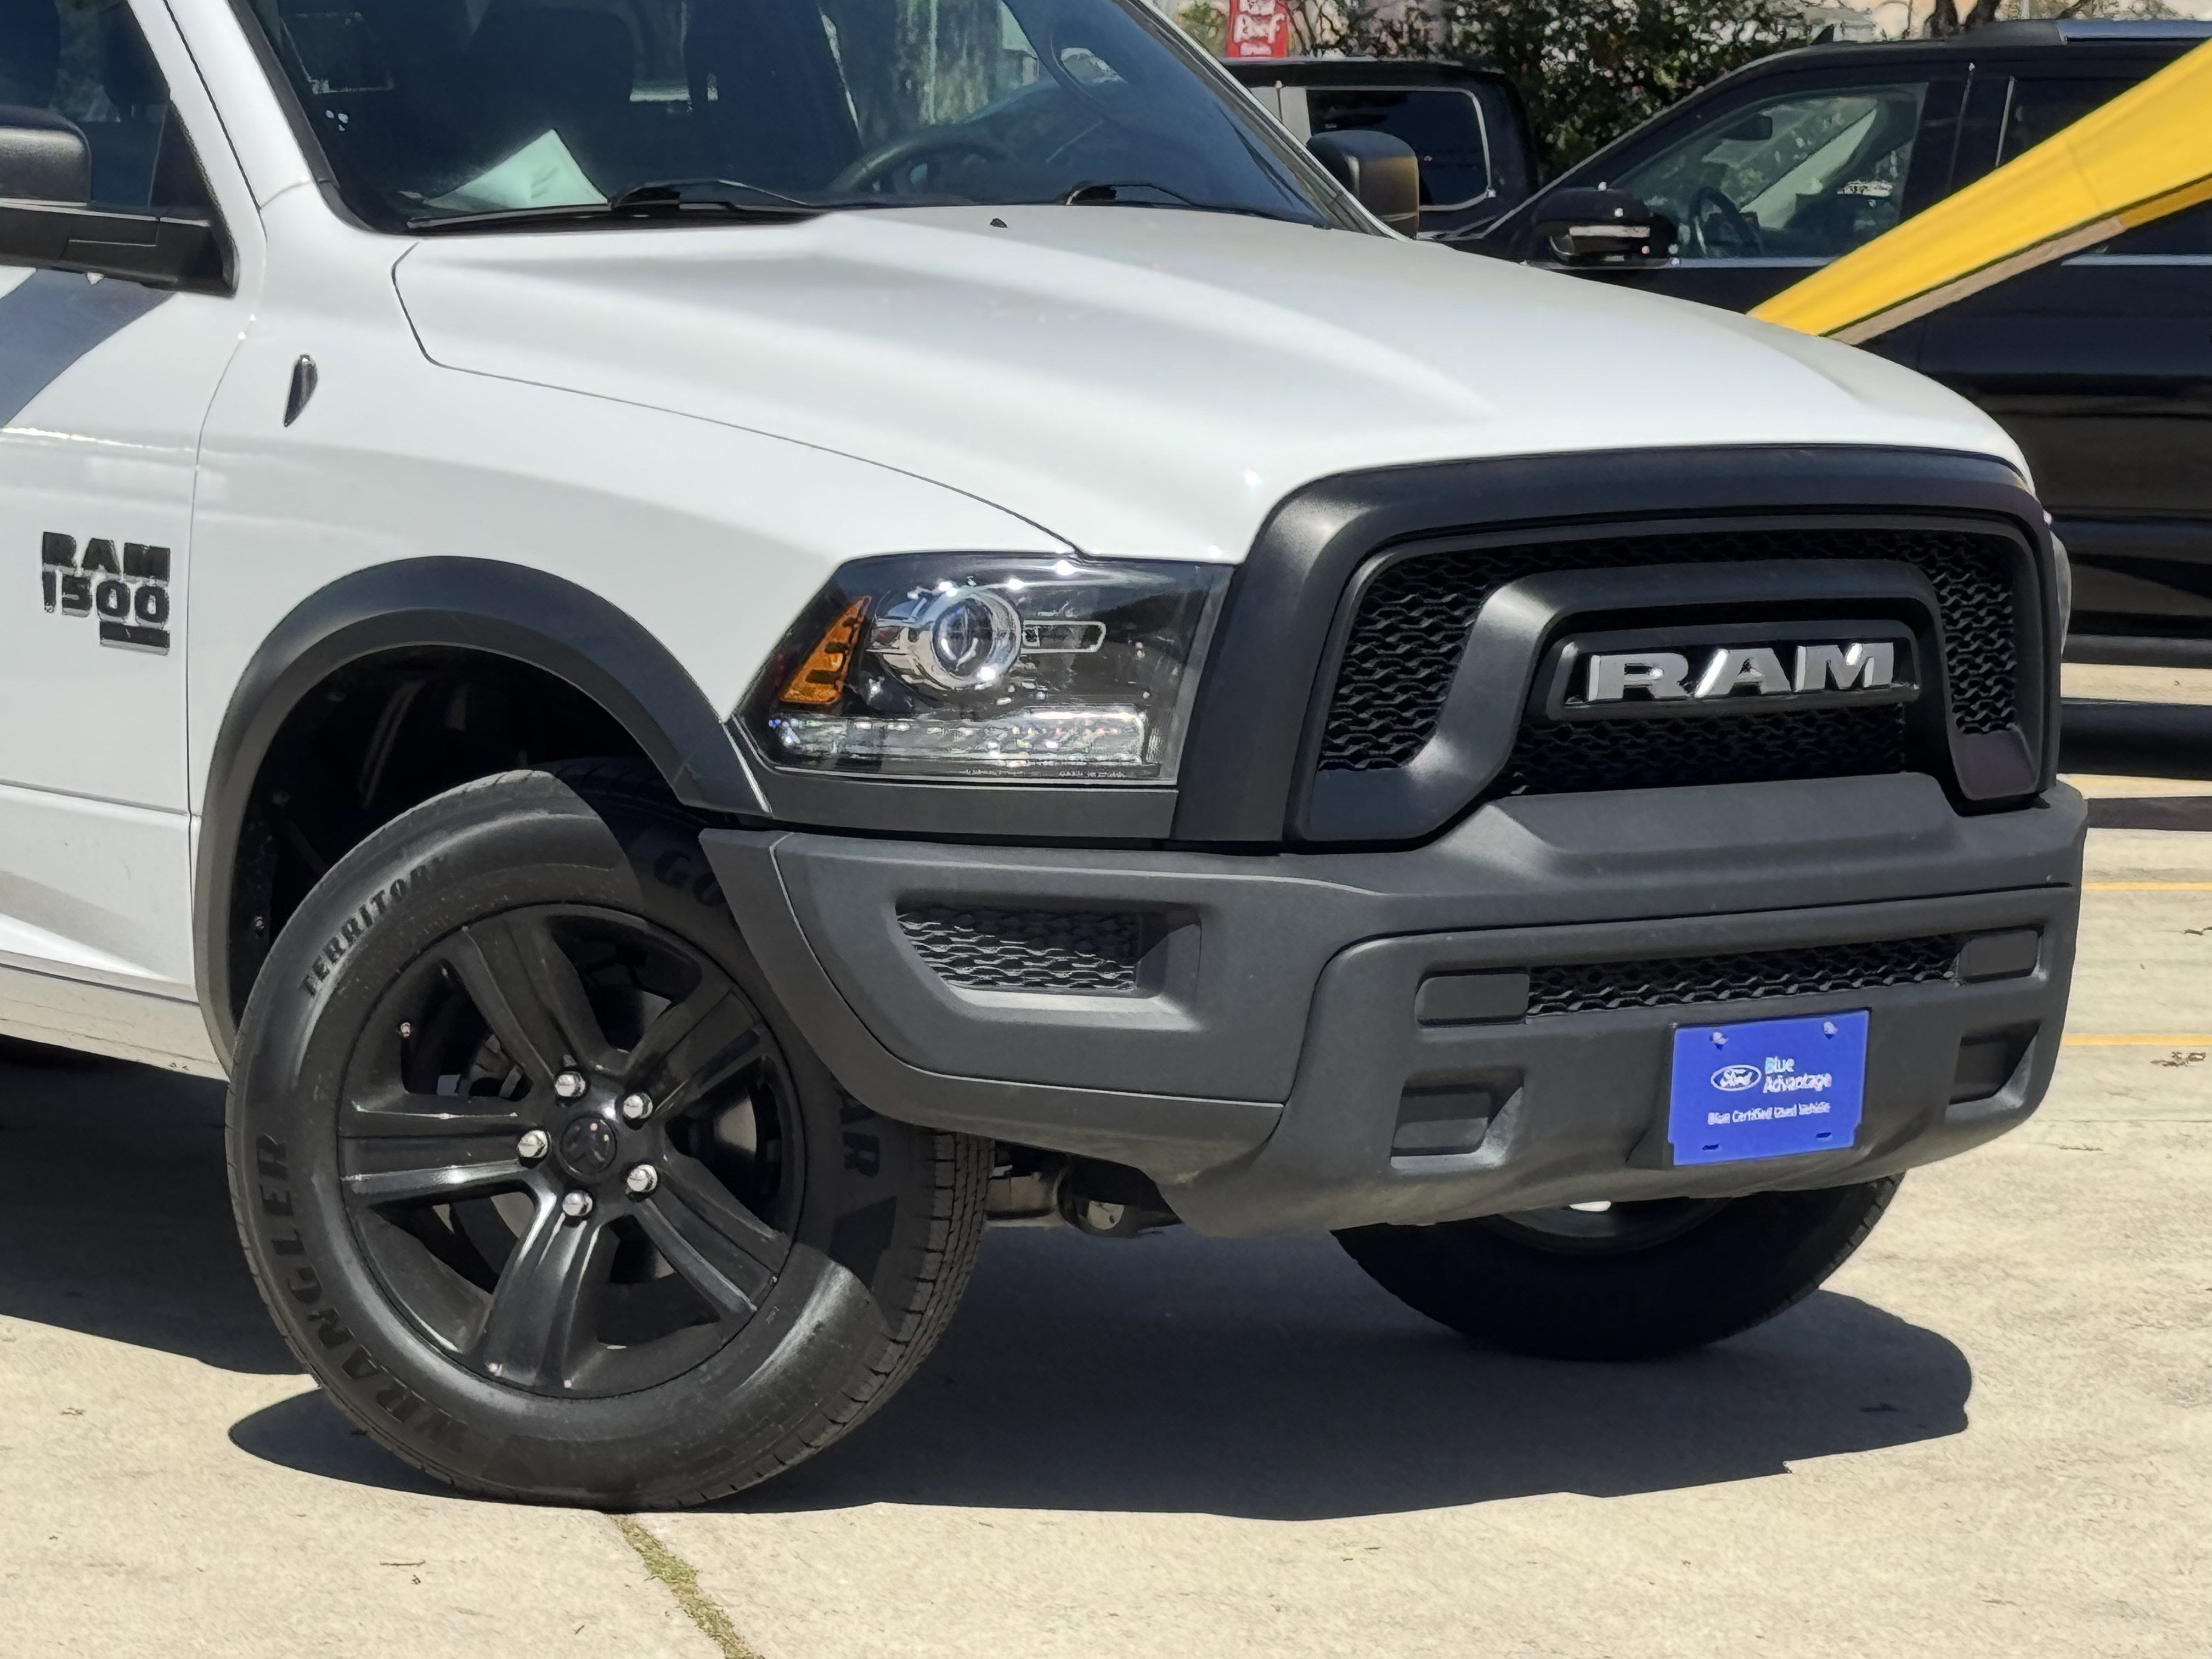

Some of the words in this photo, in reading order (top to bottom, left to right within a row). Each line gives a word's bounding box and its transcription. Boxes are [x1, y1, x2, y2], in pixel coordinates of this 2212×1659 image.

[42, 531, 171, 583] RAM
[42, 571, 170, 631] 1500
[1587, 642, 1894, 701] RAM
[1764, 1056, 1795, 1074] Blue
